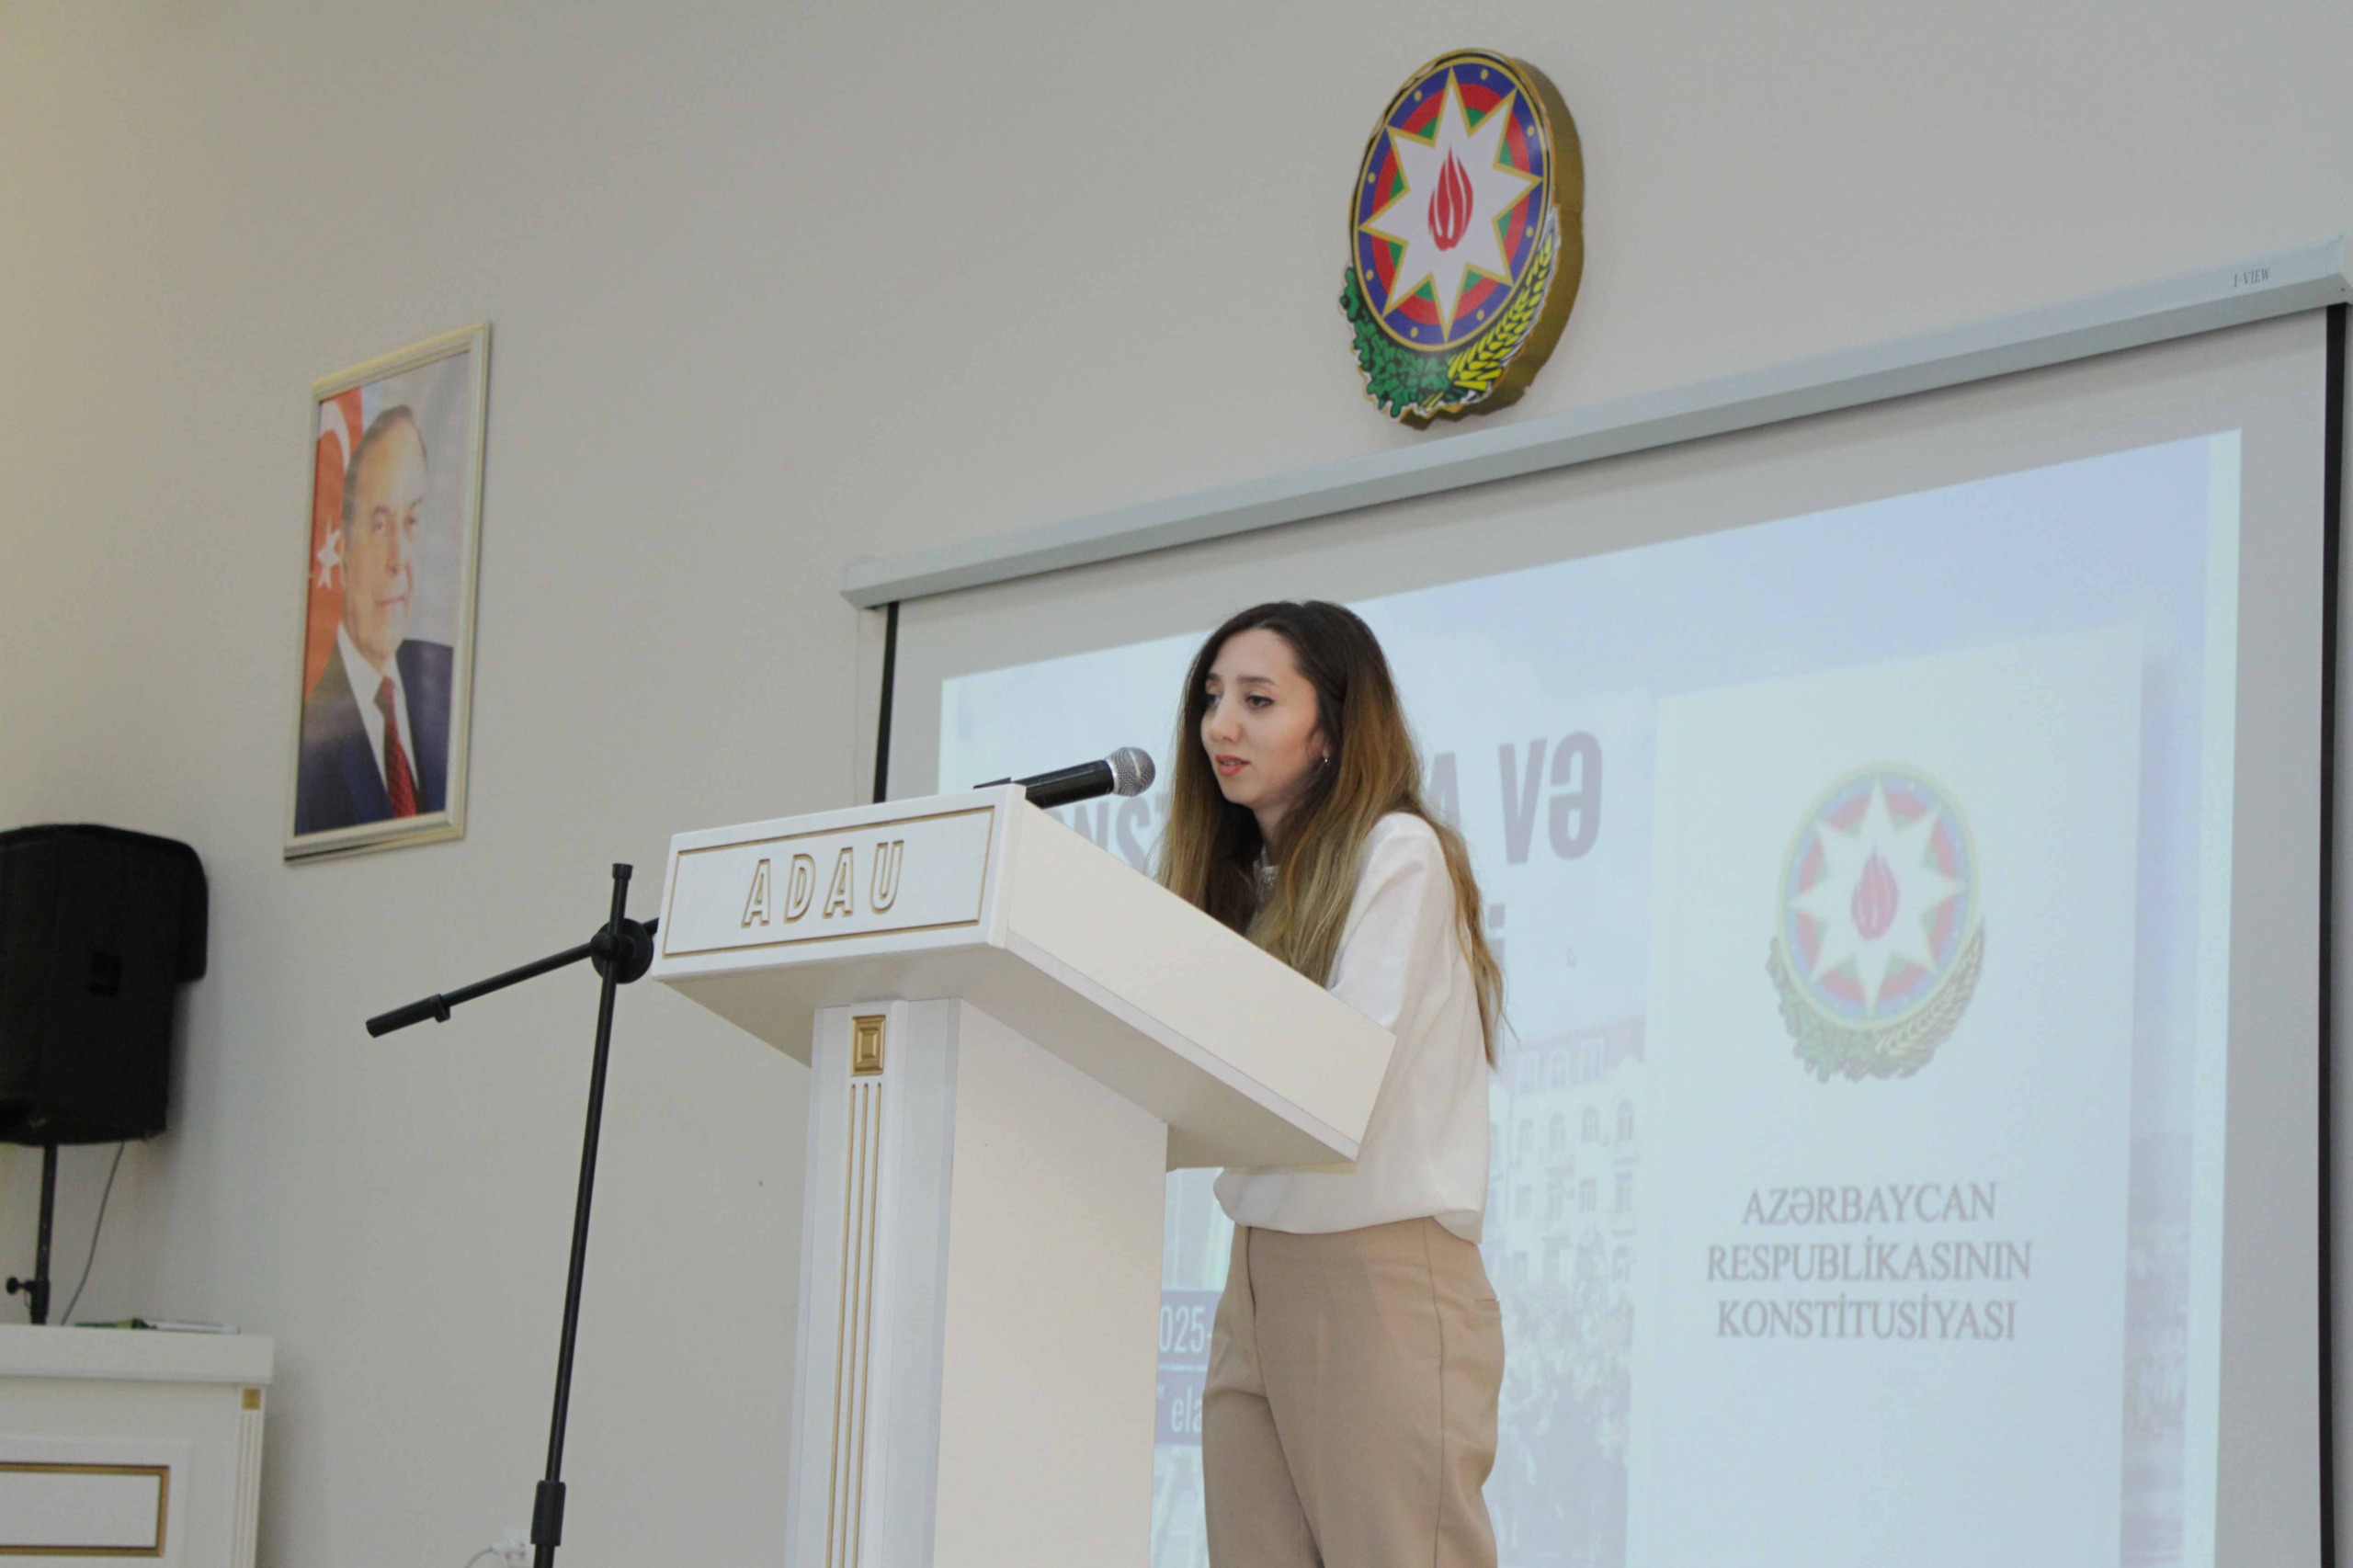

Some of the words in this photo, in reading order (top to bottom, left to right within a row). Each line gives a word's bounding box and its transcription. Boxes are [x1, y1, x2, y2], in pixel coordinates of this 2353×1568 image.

[1498, 731, 1603, 866] VƏ
[740, 839, 904, 928] ADAU
[1742, 1182, 1998, 1226] AZƏRBAYCAN
[1707, 1236, 2032, 1282] RESPUBLİKASININ
[1716, 1293, 2018, 1341] KONSTİTUSİYASI
[1170, 1385, 1202, 1434] ela
